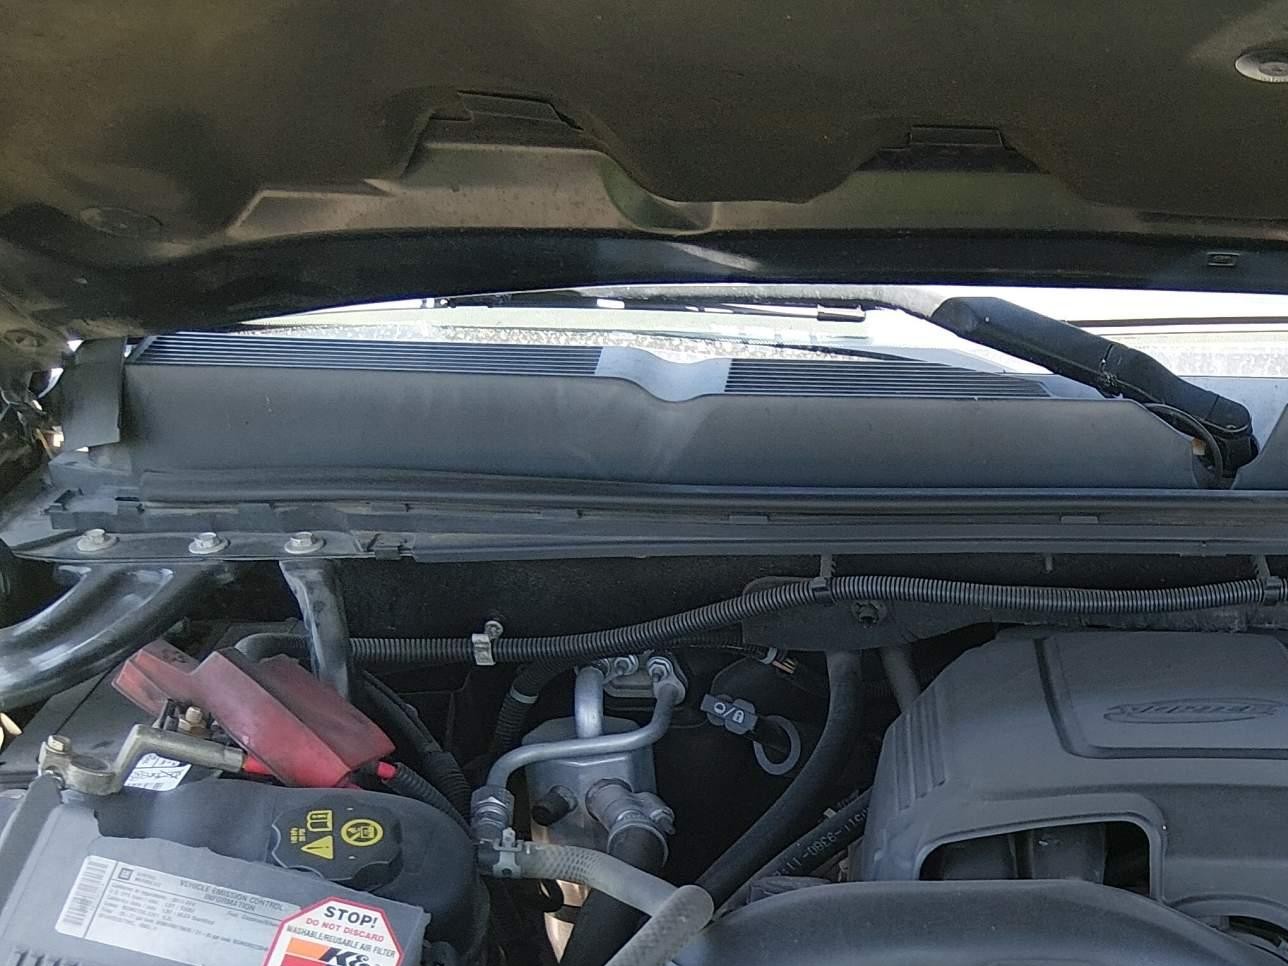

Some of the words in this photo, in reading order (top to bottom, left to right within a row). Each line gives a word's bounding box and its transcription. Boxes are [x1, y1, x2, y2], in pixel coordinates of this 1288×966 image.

[180, 880, 210, 893] VEHICLE
[211, 886, 249, 901] EMISSION
[249, 895, 284, 911] CONTROL
[204, 894, 256, 911] INFORMATION
[305, 917, 319, 926] DO
[321, 921, 340, 932] NOT
[343, 926, 385, 943] DISCARD
[324, 906, 378, 928] STOP!
[286, 925, 359, 949] WASHABLE/REUSABLE
[360, 943, 373, 952] AIR
[373, 945, 396, 958] FILTER
